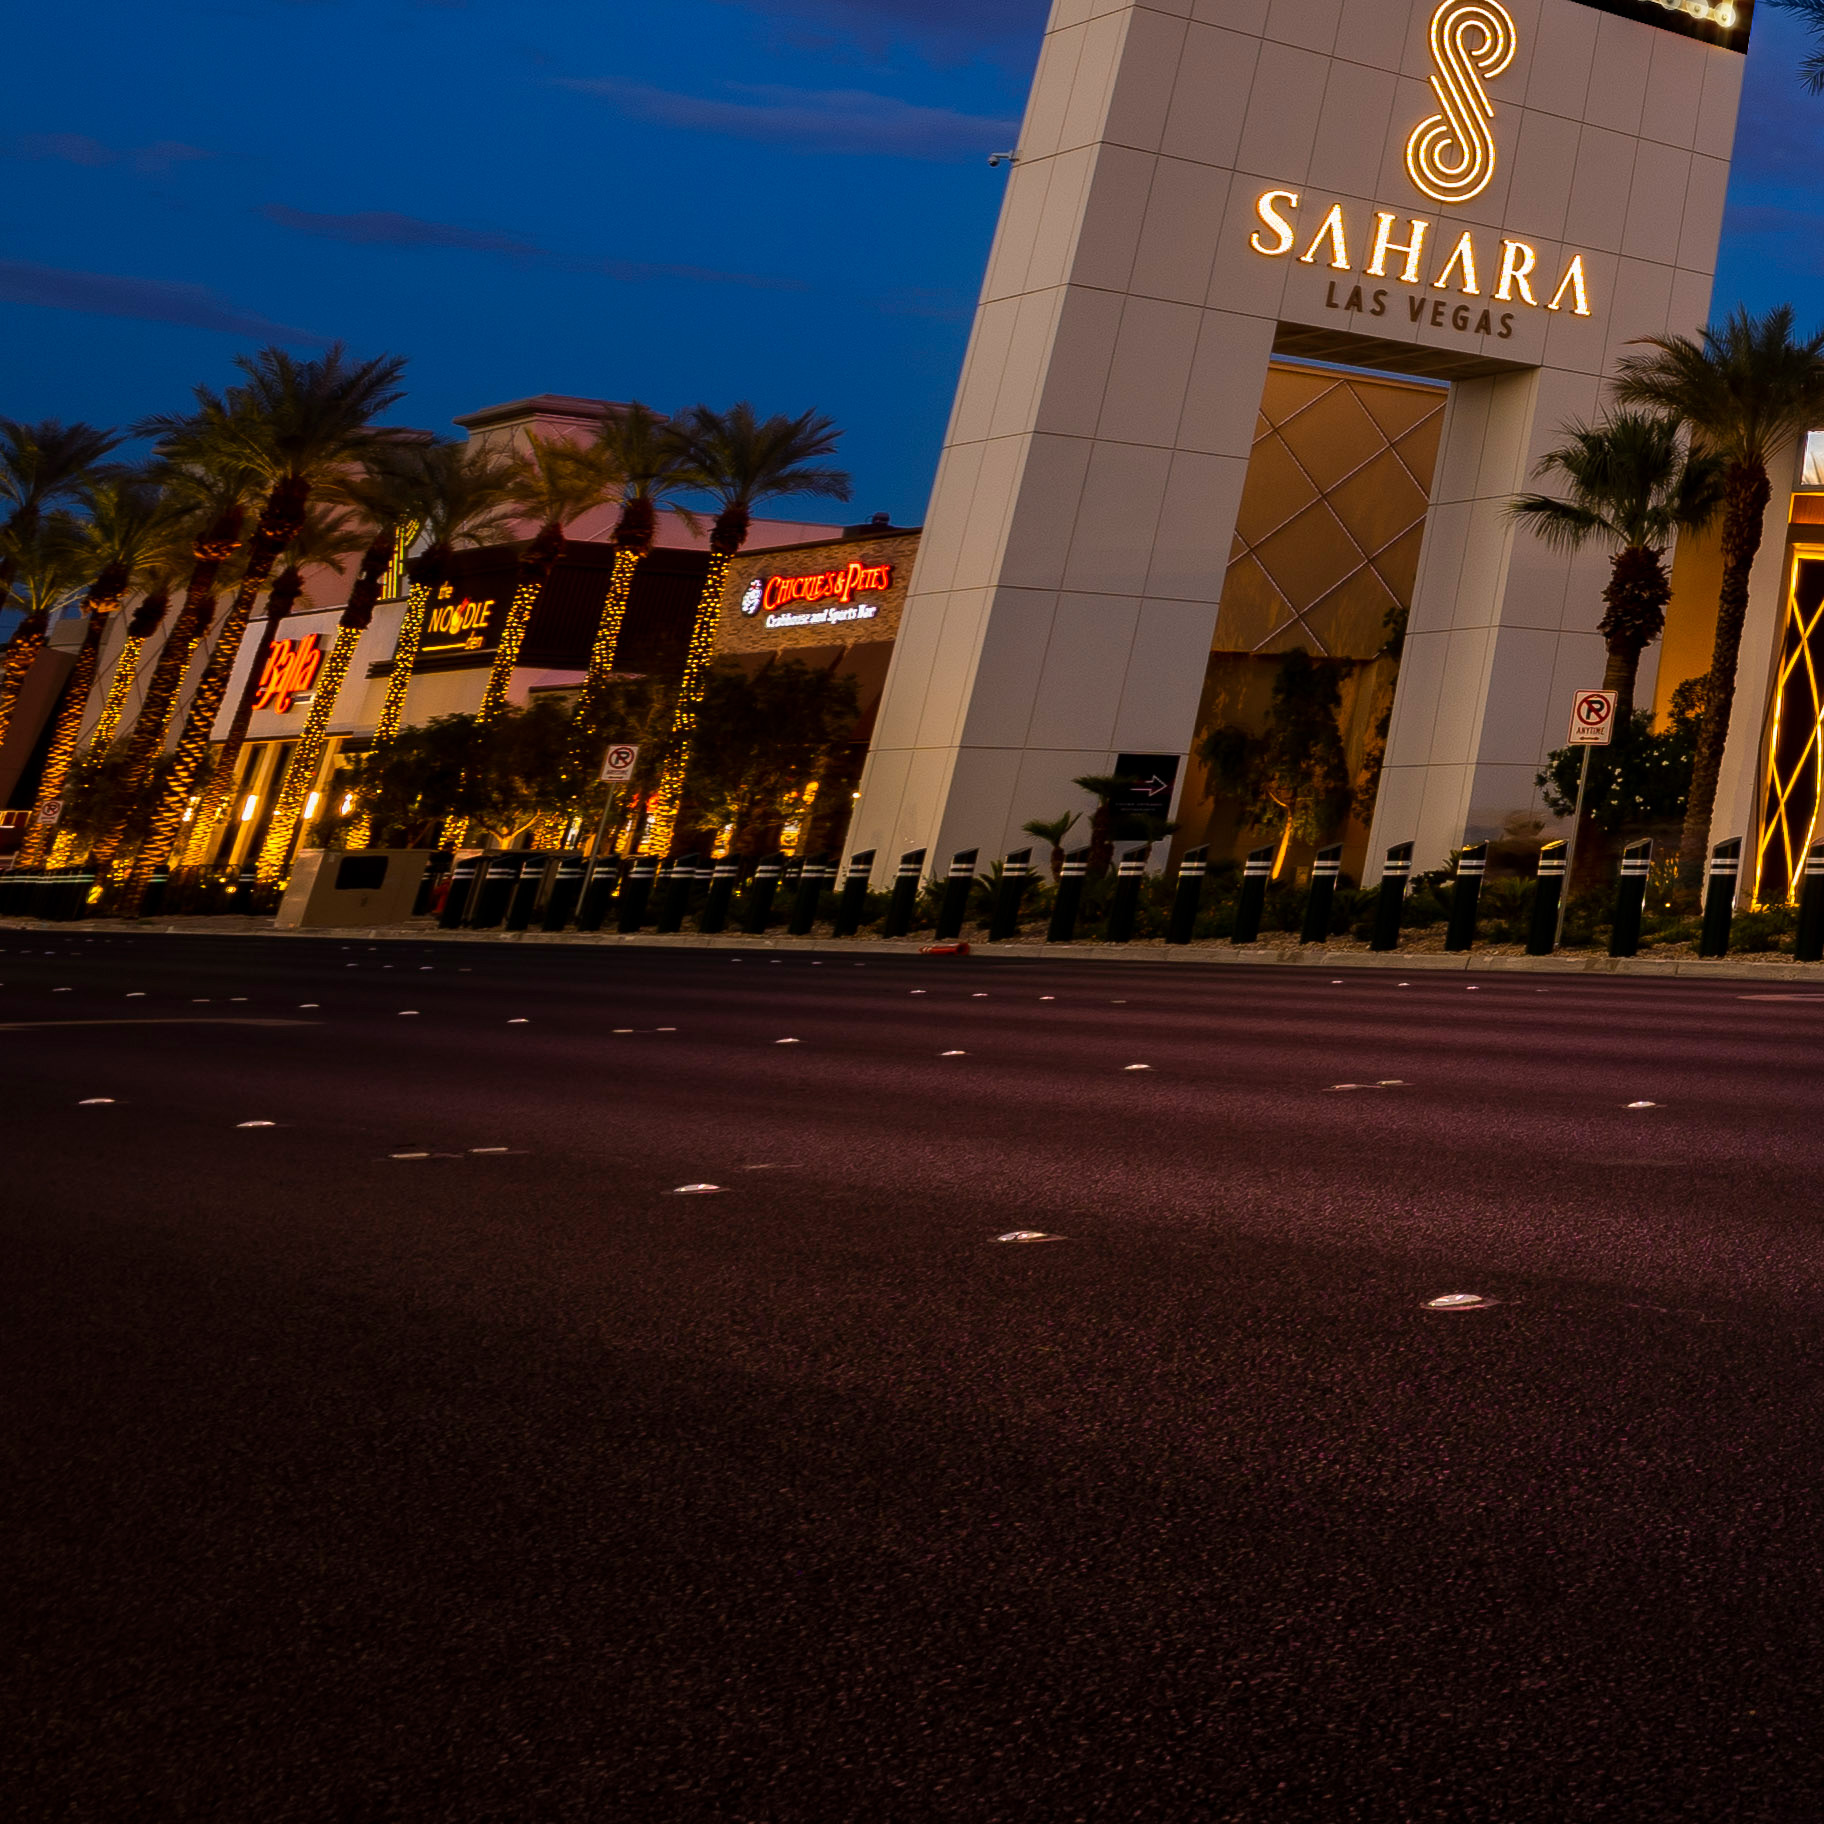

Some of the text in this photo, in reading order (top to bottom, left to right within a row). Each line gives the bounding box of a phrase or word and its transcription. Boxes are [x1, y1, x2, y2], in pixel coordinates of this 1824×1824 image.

[1249, 188, 1592, 317] SAHARA
[1326, 280, 1514, 340] LAS VEGAS
[1575, 726, 1605, 735] ANYTIME
